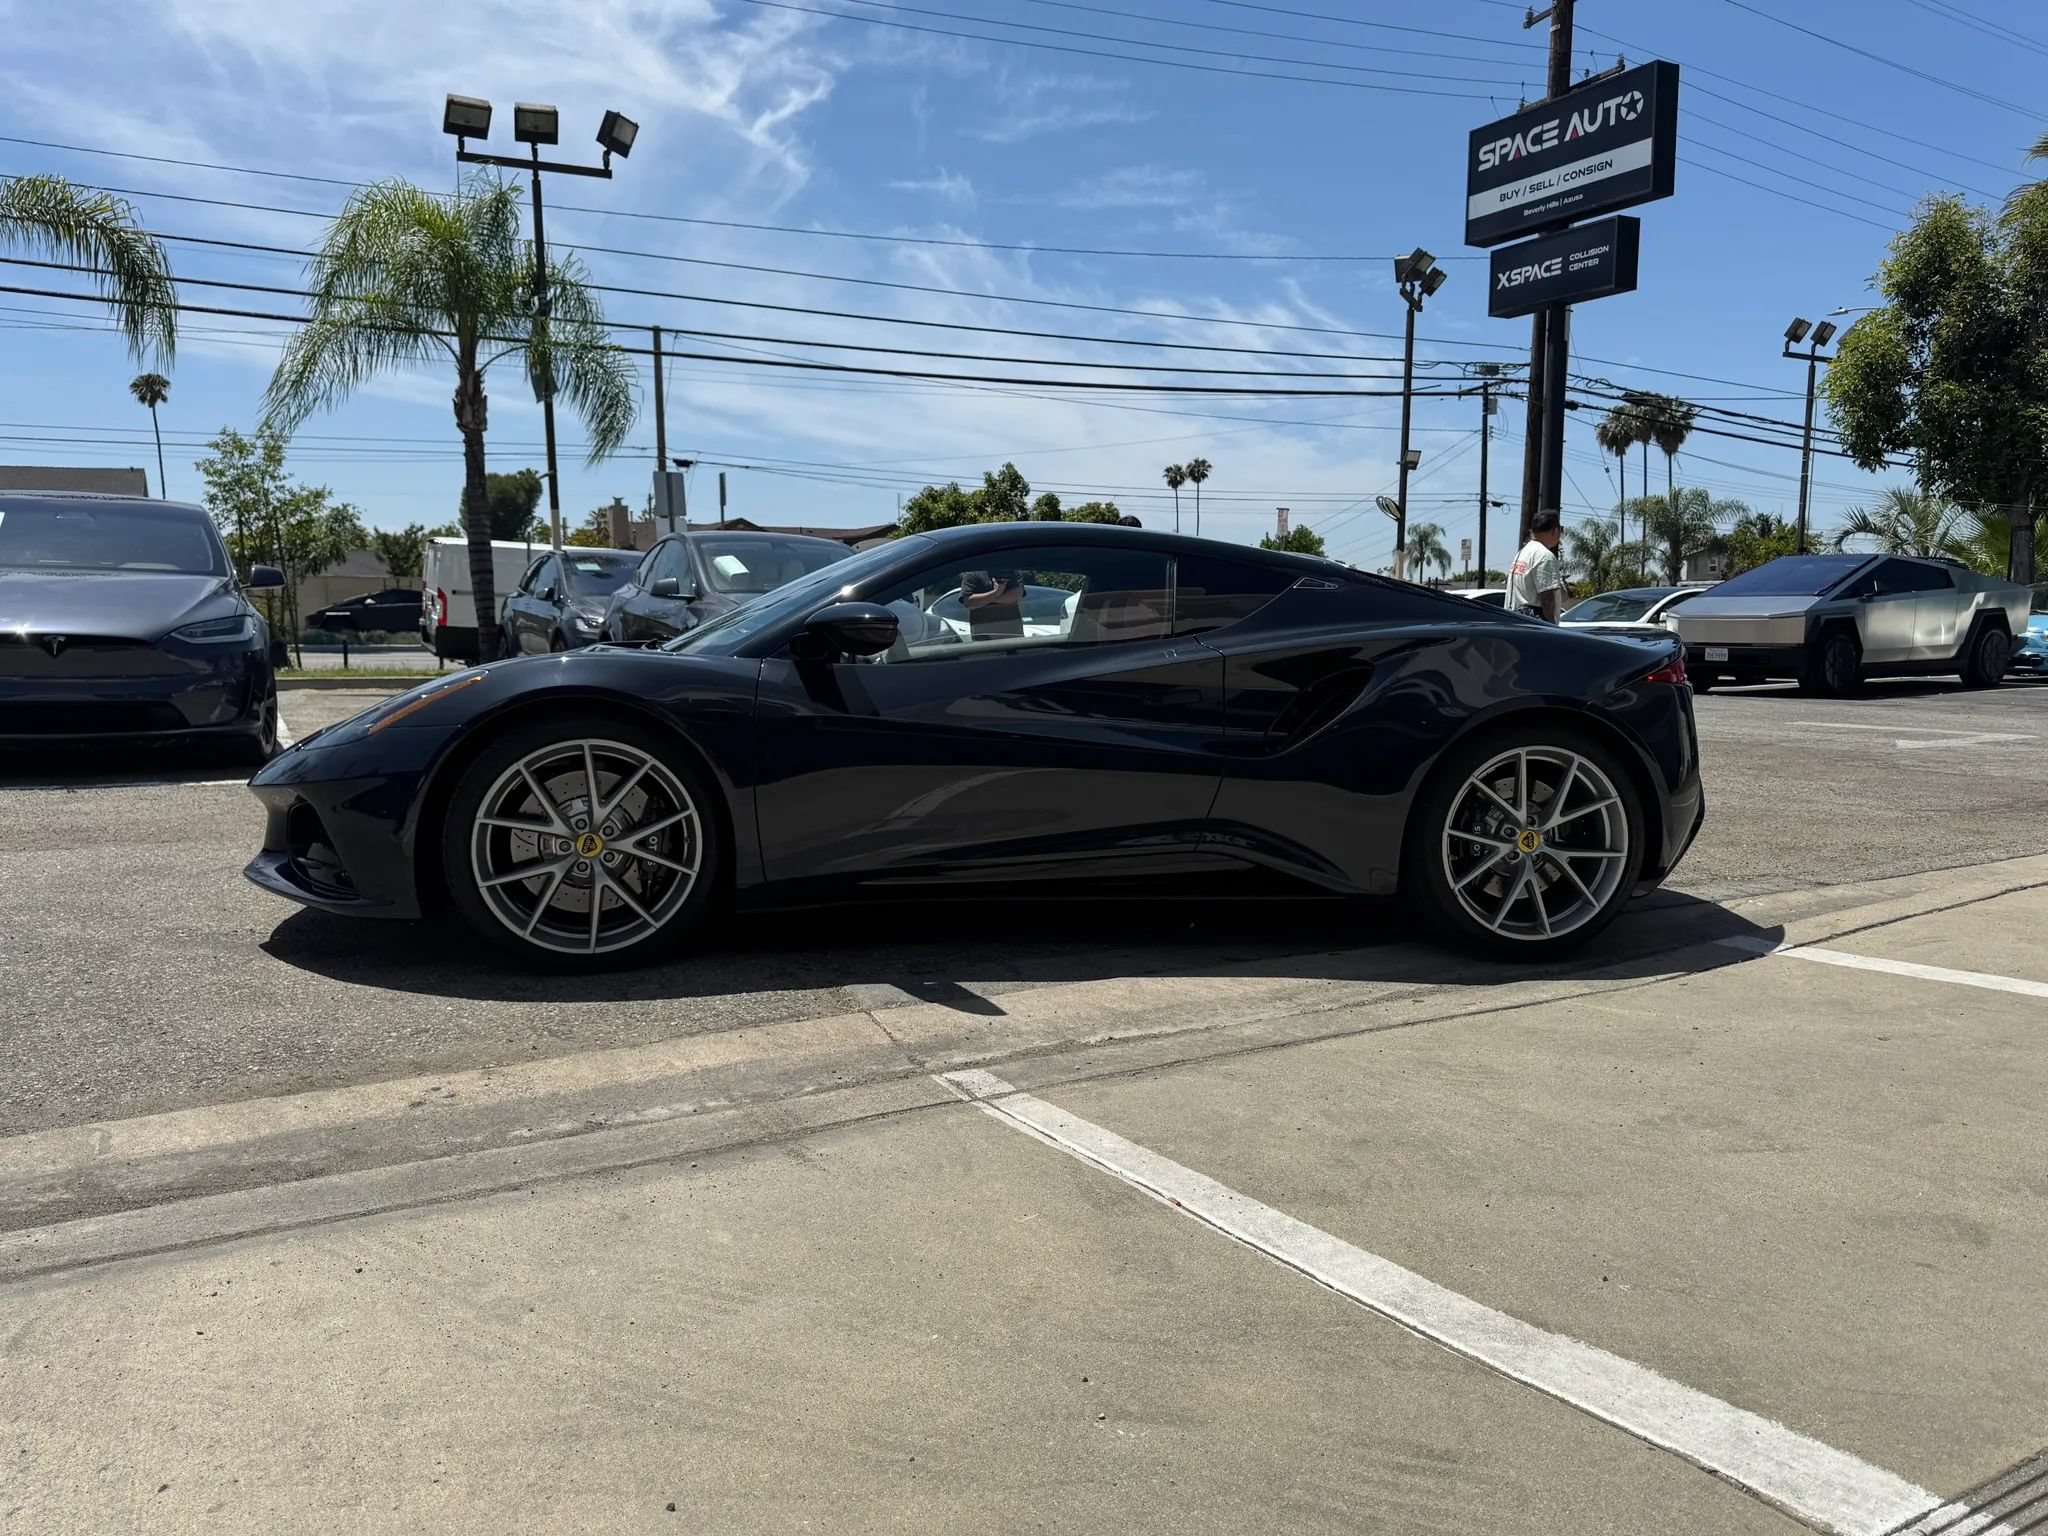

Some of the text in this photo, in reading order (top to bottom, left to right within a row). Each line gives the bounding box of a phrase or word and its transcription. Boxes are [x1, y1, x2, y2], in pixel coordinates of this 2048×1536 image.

[1478, 91, 1643, 171] SPACE AUTO
[1500, 189, 1520, 202] BUY
[1529, 178, 1554, 193] SELL
[1563, 159, 1612, 182] CONSIGN
[1524, 205, 1545, 216] Beverly
[1563, 194, 1583, 205] Azusa
[1569, 245, 1609, 261] COLLISION
[1569, 258, 1599, 271] CENTER
[1497, 258, 1562, 289] XSPACE
[1473, 825, 1481, 856] LOS
